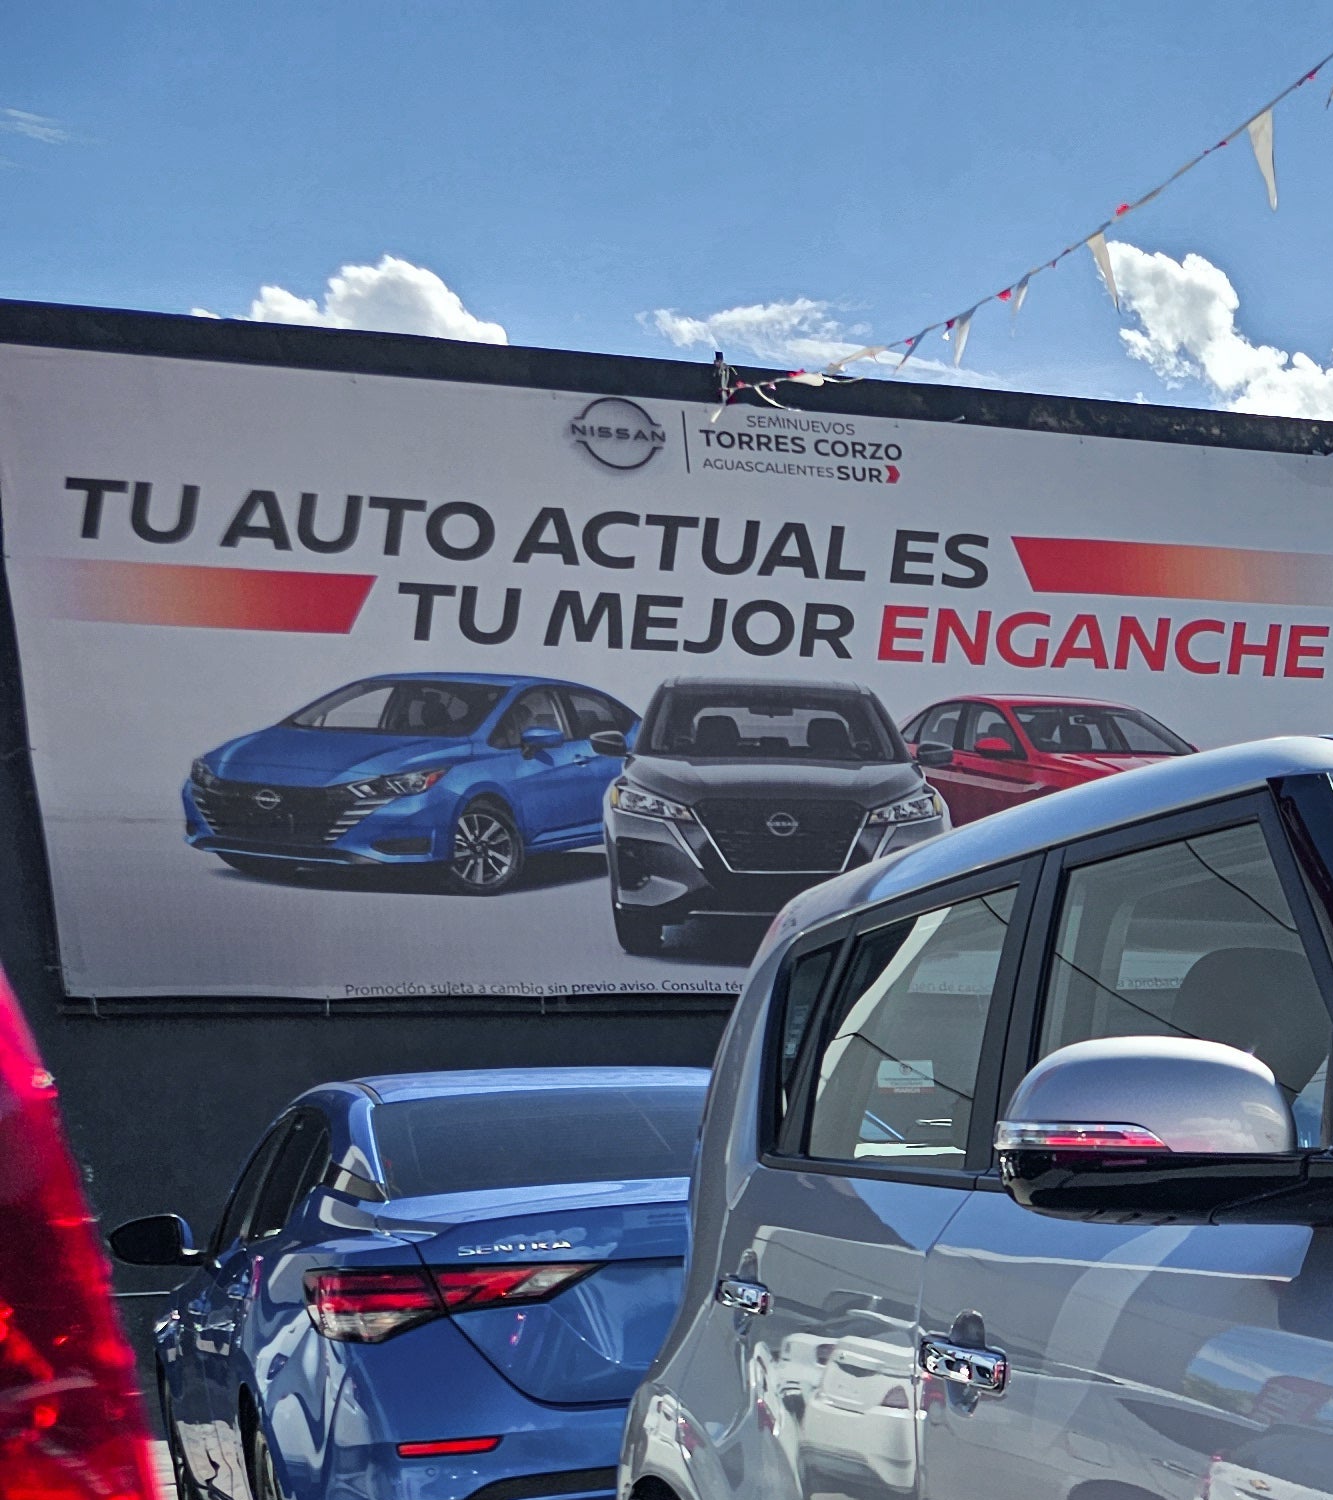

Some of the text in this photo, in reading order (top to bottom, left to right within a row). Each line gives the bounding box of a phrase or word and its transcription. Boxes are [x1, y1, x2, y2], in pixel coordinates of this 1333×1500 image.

[571, 423, 666, 443] NISSAN
[746, 415, 855, 436] SEMINUEVOS
[699, 428, 903, 461] TORRES CORZO
[702, 457, 883, 483] AGUASCALIENTES SUR
[65, 476, 989, 589] TU AUTO ACTUAL ES
[398, 582, 1331, 680] TU MEJOR ENGANCHE
[345, 981, 427, 996] Promoción
[430, 981, 474, 996] sujeta
[478, 984, 487, 994] a
[490, 982, 545, 995] cambio
[547, 982, 568, 995] sin
[571, 981, 616, 995] previo
[619, 981, 658, 992] aviso.
[661, 979, 722, 992] Consulta
[457, 1240, 572, 1257] SENTRA
